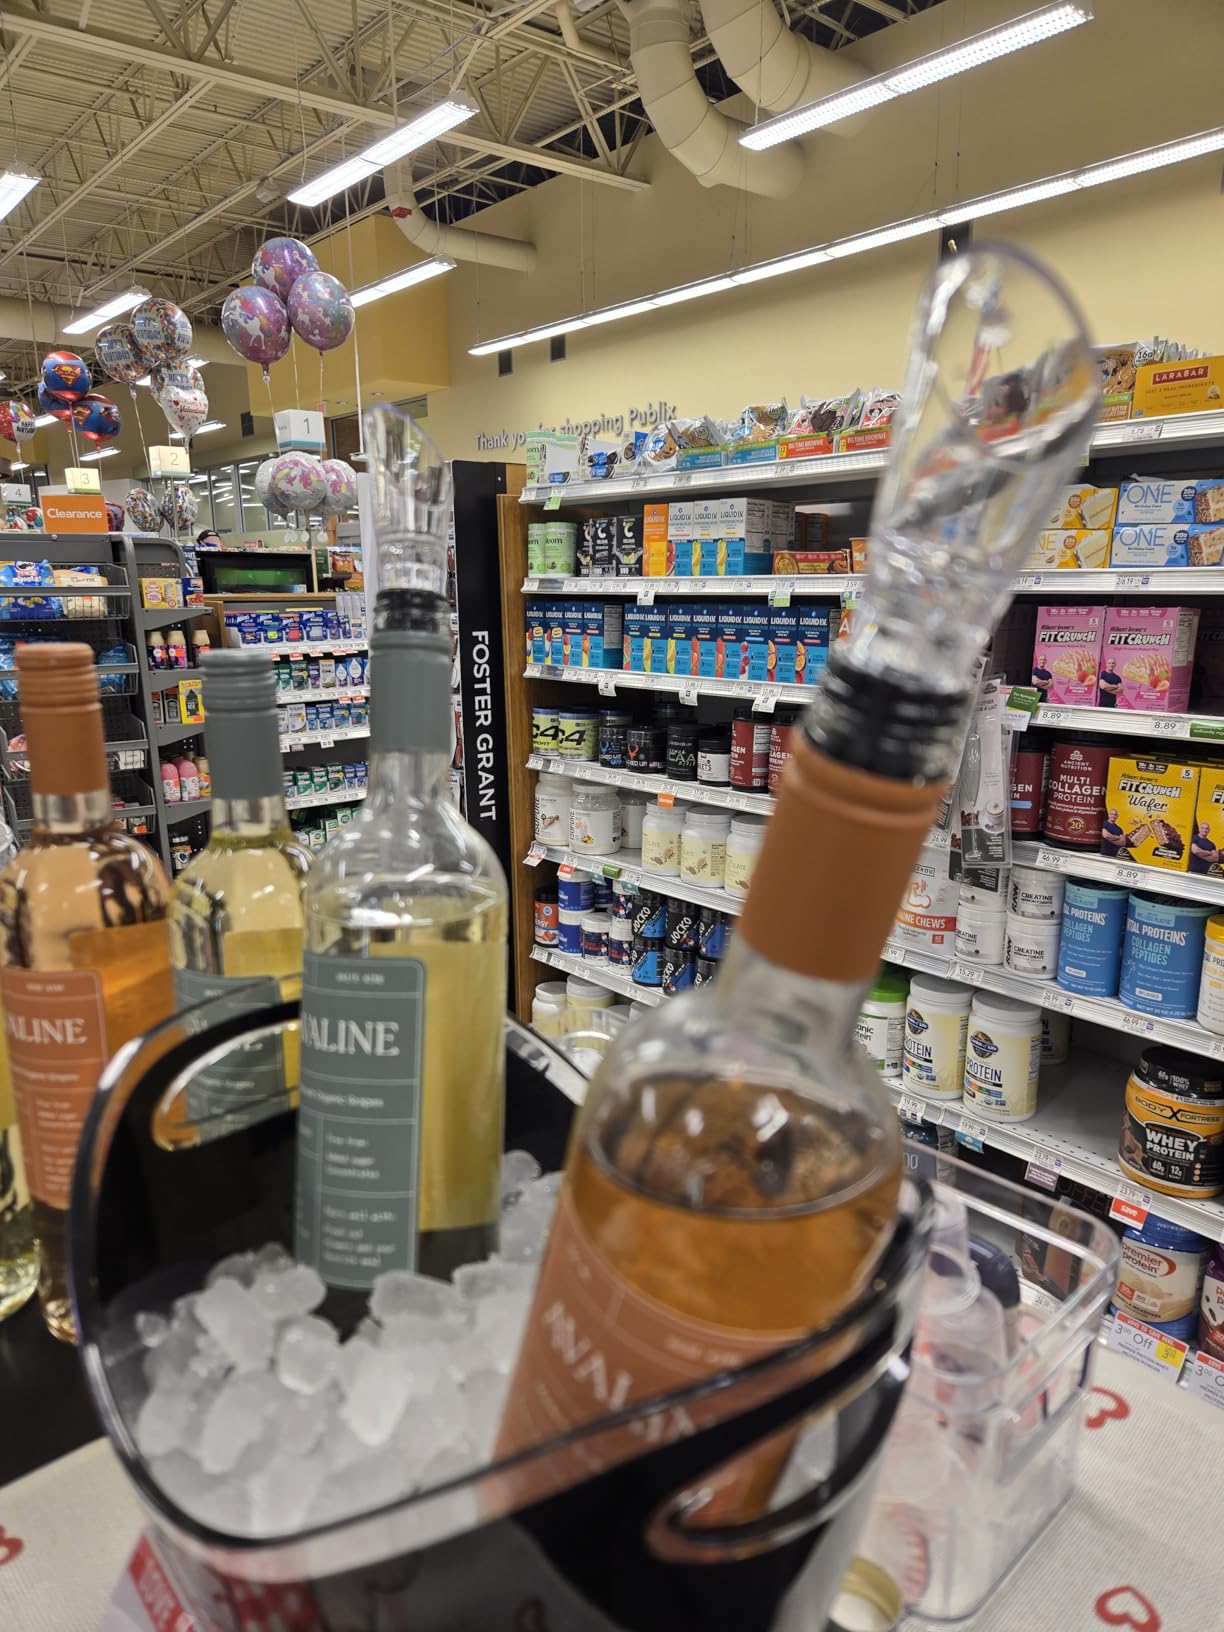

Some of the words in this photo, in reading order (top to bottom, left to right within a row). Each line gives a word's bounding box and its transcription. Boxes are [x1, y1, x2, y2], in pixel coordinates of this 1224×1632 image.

[1155, 368, 1204, 382] LARABAR
[304, 418, 310, 434] 1
[475, 428, 508, 451] Thank
[512, 432, 526, 450] yo
[560, 413, 623, 437] shopping
[629, 401, 677, 427] Publix
[170, 452, 180, 466] 2
[82, 473, 90, 485] 3
[15, 488, 22, 497] 4
[1127, 484, 1175, 504] ONE
[47, 508, 103, 519] Clearance
[669, 513, 686, 521] LIQUID
[695, 512, 711, 520] LIQUID
[720, 510, 737, 519] LIQUID
[1120, 528, 1168, 547] ONE
[472, 630, 492, 728] FOSTER
[1042, 712, 1061, 720] 8.89
[1154, 721, 1176, 730] 8.89
[1061, 764, 1092, 772] NUTRITION
[476, 733, 496, 821] GRANT
[1060, 774, 1090, 785] MULTI
[1054, 792, 1095, 804] PROTEIN
[1128, 795, 1168, 811] Wafer
[1042, 854, 1061, 864] 46.99
[1117, 870, 1138, 879] 8.89
[1021, 892, 1053, 901] CREATINE
[633, 907, 651, 932] JOCKO
[916, 915, 946, 929] CHEWS
[1071, 908, 1105, 926] PROTEINS
[670, 917, 692, 944] JOCKO
[1064, 928, 1091, 942] PEPTIDES
[1142, 925, 1186, 946] PROTEINS
[1014, 945, 1044, 956] CREATINE
[1132, 936, 1171, 955] COLLAGEN
[1131, 947, 1168, 966] PEPTIDES
[959, 968, 975, 977] 15.29
[1123, 1017, 1139, 1026] 46.99
[8, 1014, 88, 1045] ALINE
[302, 1012, 400, 1056] ALINE
[966, 1056, 1002, 1082] PROTEIN
[1172, 1075, 1190, 1085] 100%
[1172, 1082, 1189, 1090] WHEY
[1135, 1095, 1167, 1114] BODY
[1145, 1128, 1198, 1152] WHEY
[1146, 1141, 1195, 1161] PROTEIN
[1152, 1160, 1165, 1172] 60g
[1170, 1165, 1182, 1177] 12g
[1120, 1205, 1138, 1217] save
[1121, 1241, 1164, 1266] premier
[1122, 1251, 1158, 1274] protein
[1133, 1333, 1153, 1349] Off
